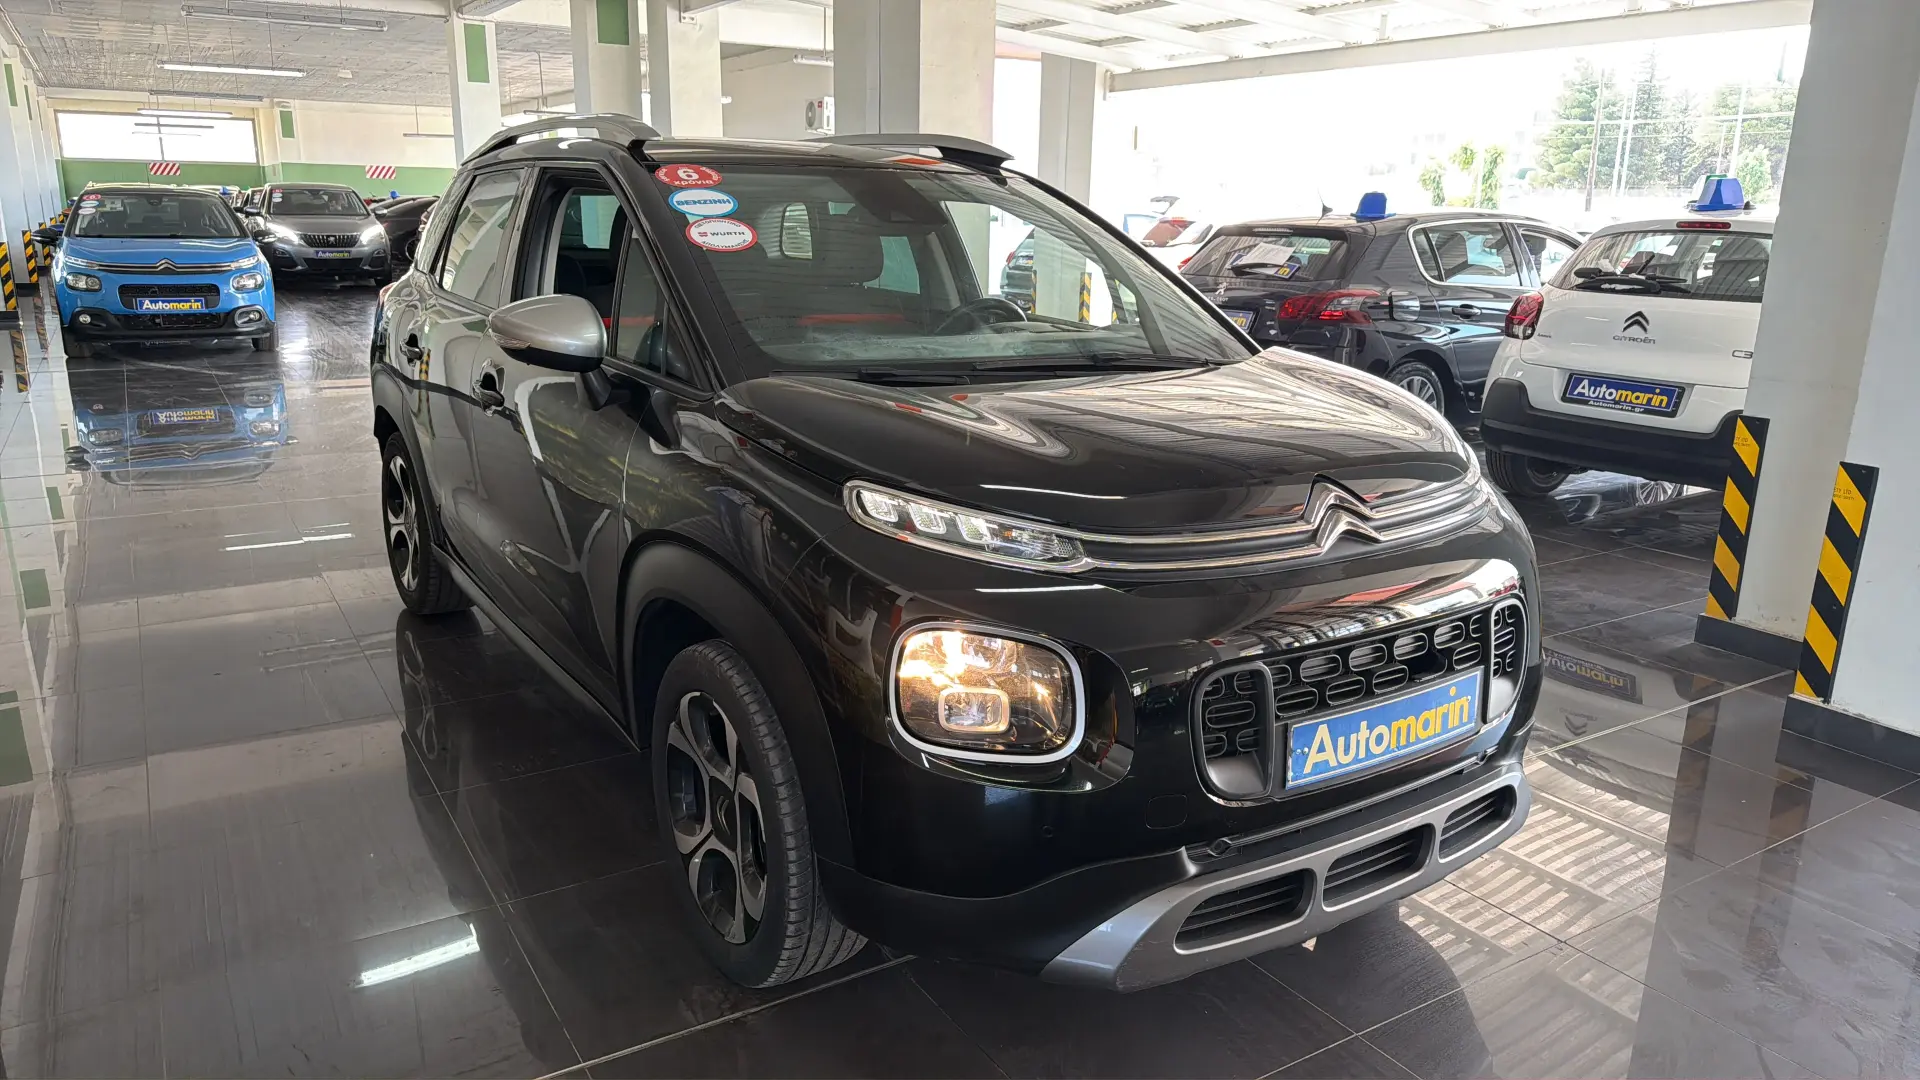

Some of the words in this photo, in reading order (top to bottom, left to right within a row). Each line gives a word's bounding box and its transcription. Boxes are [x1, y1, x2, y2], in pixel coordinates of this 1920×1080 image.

[677, 169, 699, 180] 6
[143, 299, 201, 310] Automarin
[1732, 350, 1753, 359] C3
[1573, 379, 1668, 407] Automarin
[1588, 400, 1645, 412] Automarin.gr
[1303, 686, 1469, 774] Automarin
